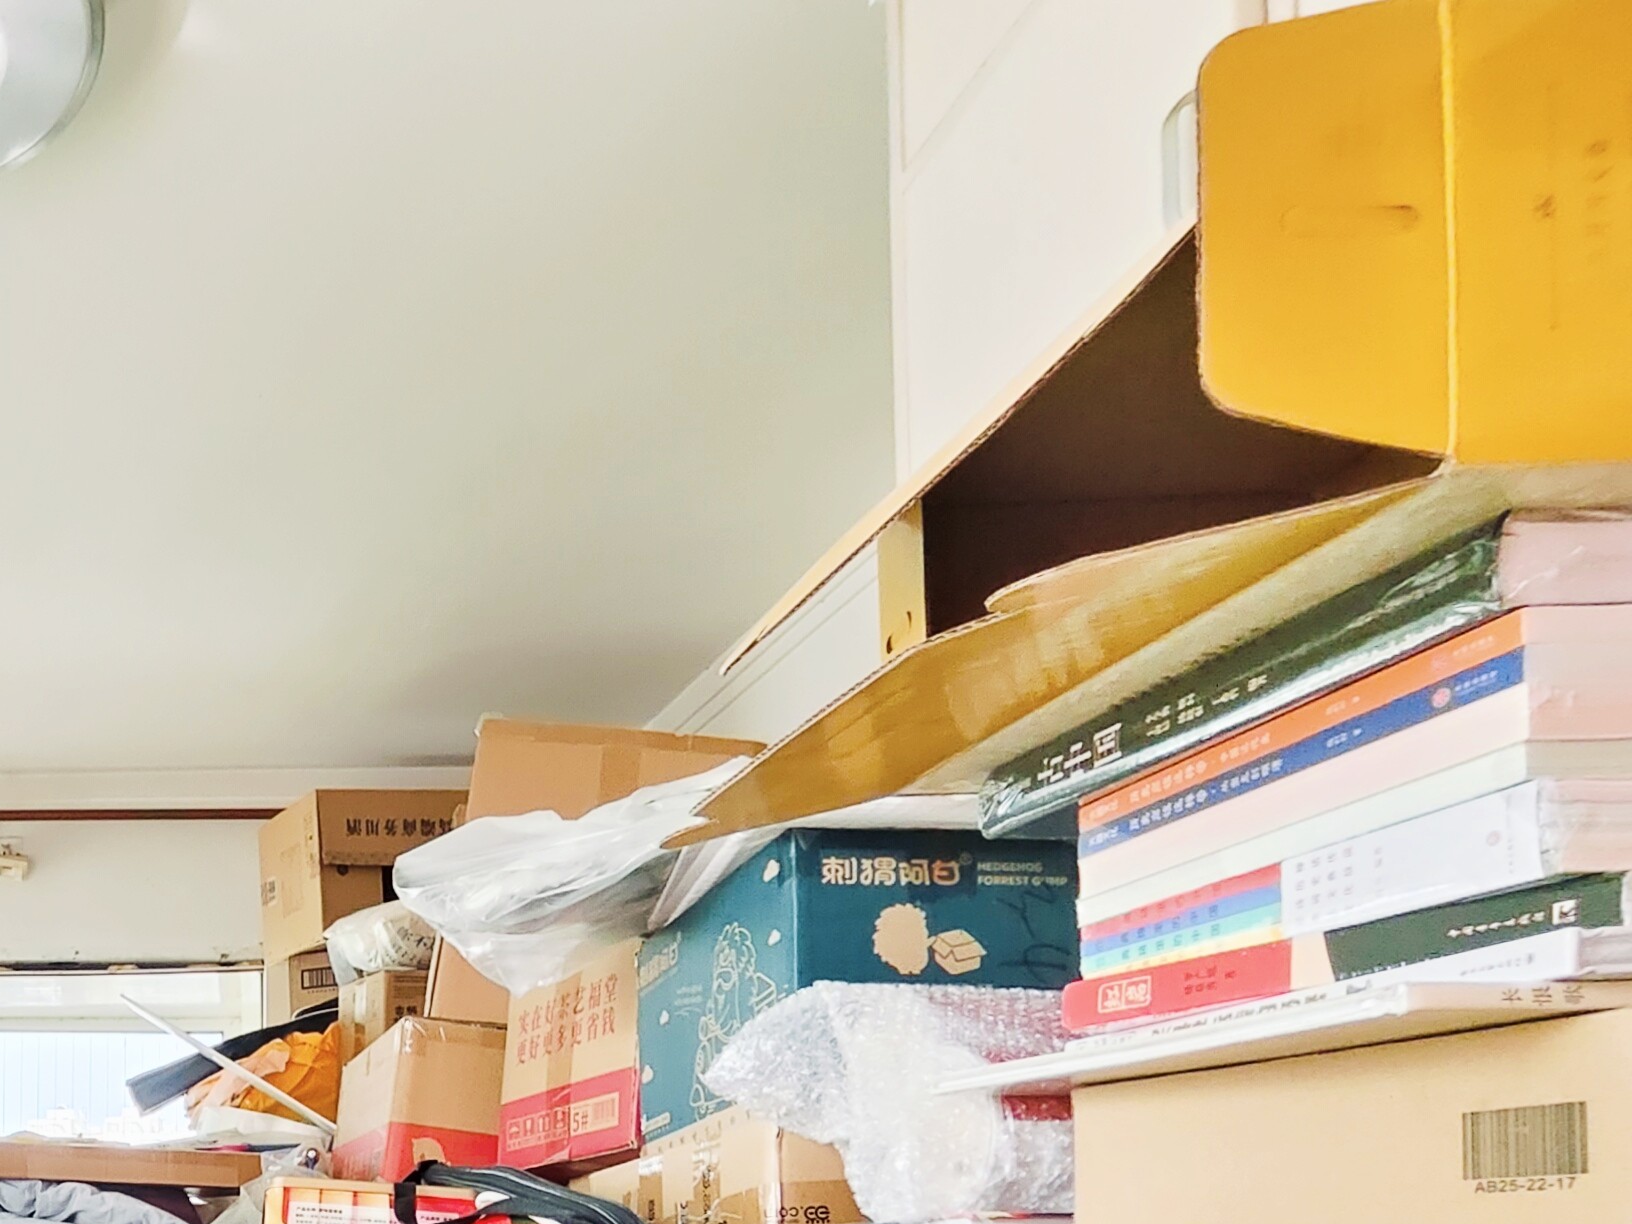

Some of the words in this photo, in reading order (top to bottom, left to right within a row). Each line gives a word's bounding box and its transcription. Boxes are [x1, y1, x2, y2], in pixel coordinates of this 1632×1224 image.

[821, 856, 961, 886] 刺猬阿白
[976, 861, 1044, 874] HEDGEHOG
[977, 875, 1030, 887] FORREST
[1102, 980, 1149, 1010] 红岩
[1500, 985, 1586, 1007] 长恨歌
[572, 1110, 589, 1134] 5#
[1473, 1176, 1578, 1195] AB25-22-17
